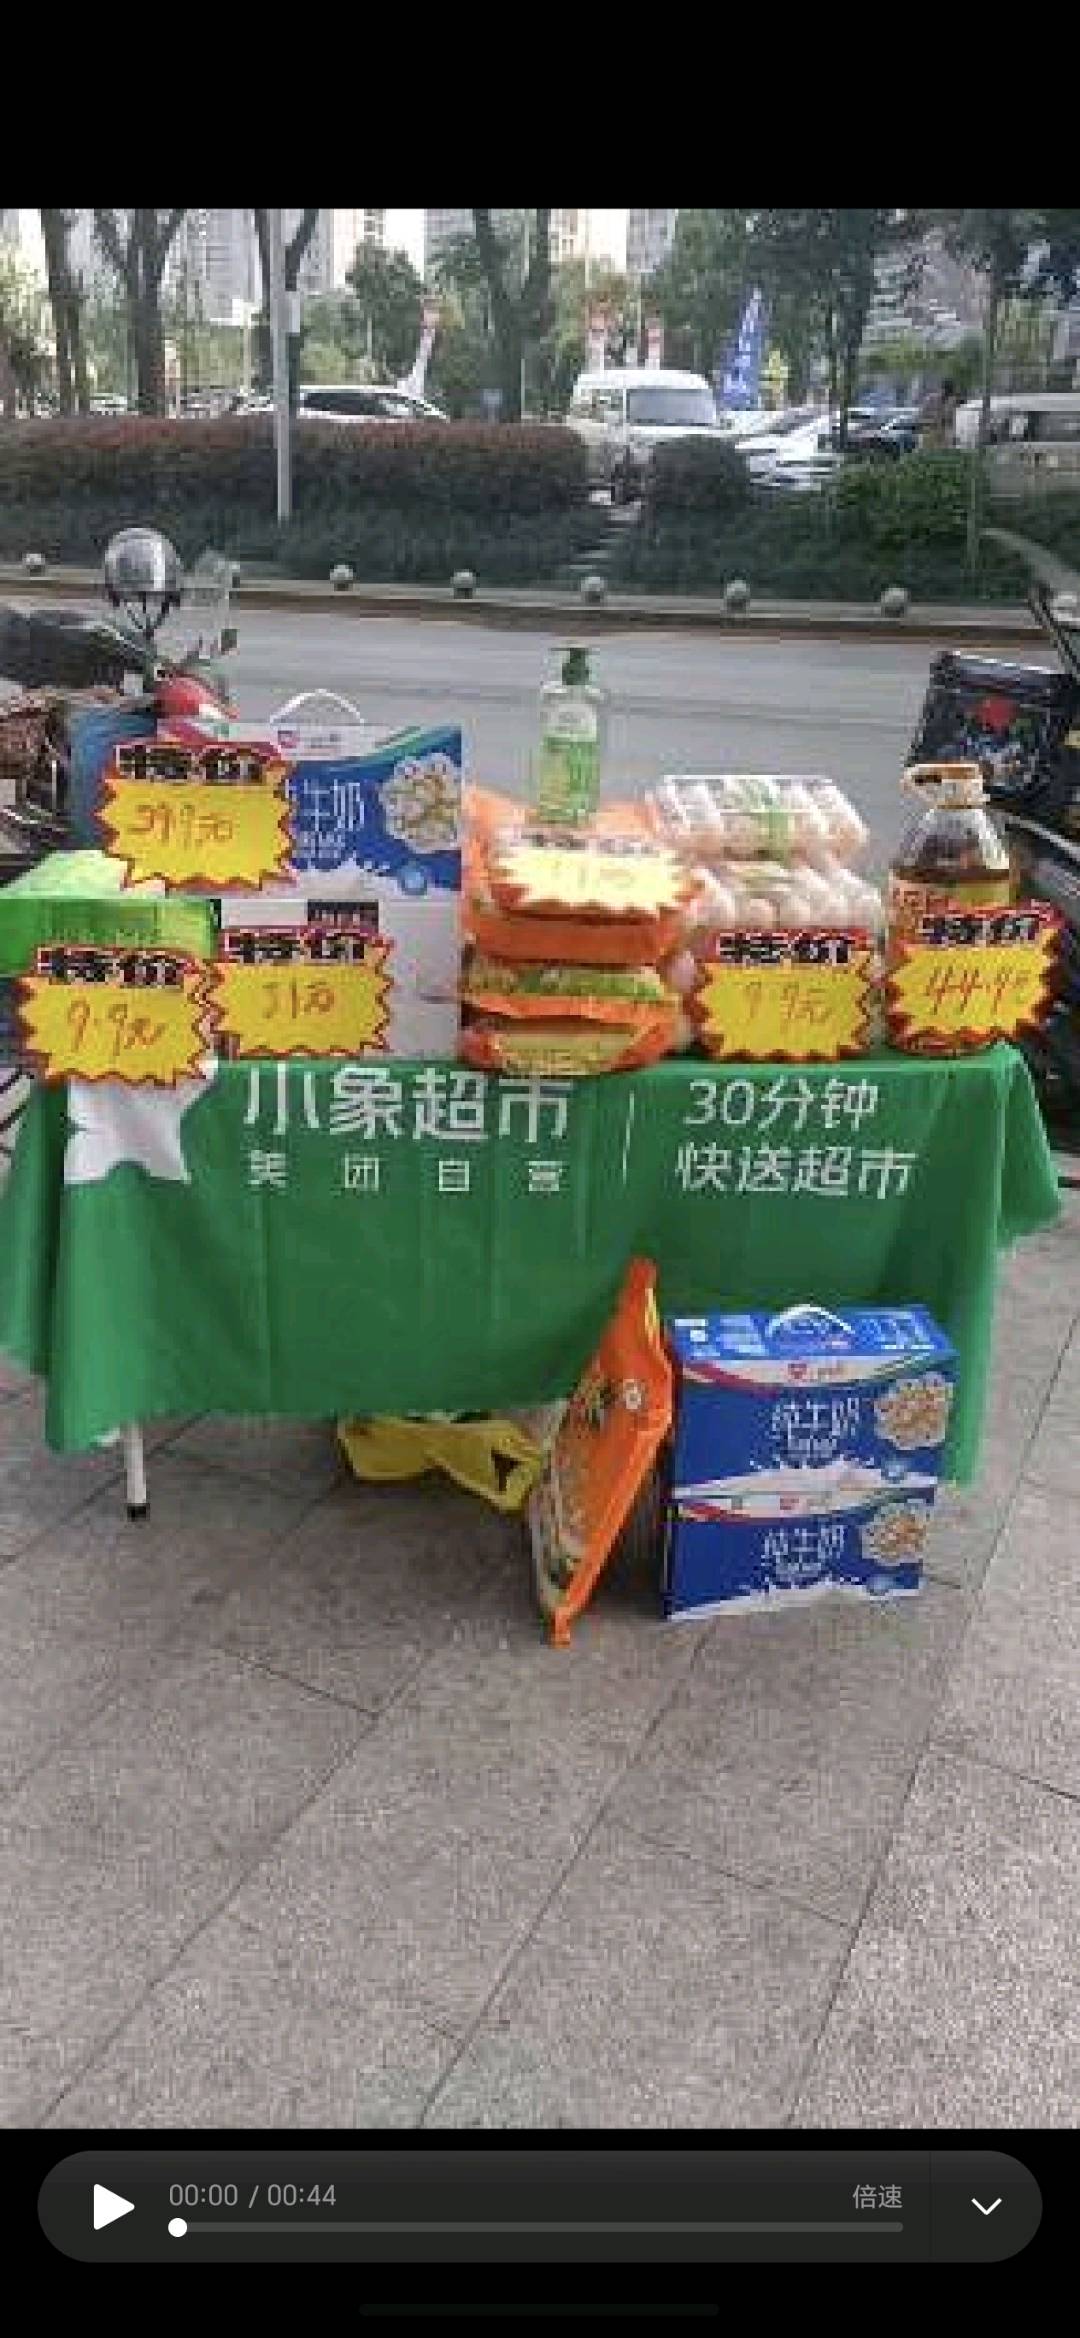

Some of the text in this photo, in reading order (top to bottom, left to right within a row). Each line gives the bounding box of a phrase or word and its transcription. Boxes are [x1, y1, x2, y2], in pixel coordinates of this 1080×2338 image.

[917, 908, 1042, 944] 特价
[38, 947, 186, 988] 特价
[225, 930, 366, 966] 特价
[718, 932, 856, 966] 特价
[243, 1064, 574, 1142] 小象超市
[684, 1075, 878, 1131] 30分钟
[675, 1142, 918, 1200] 快送超市
